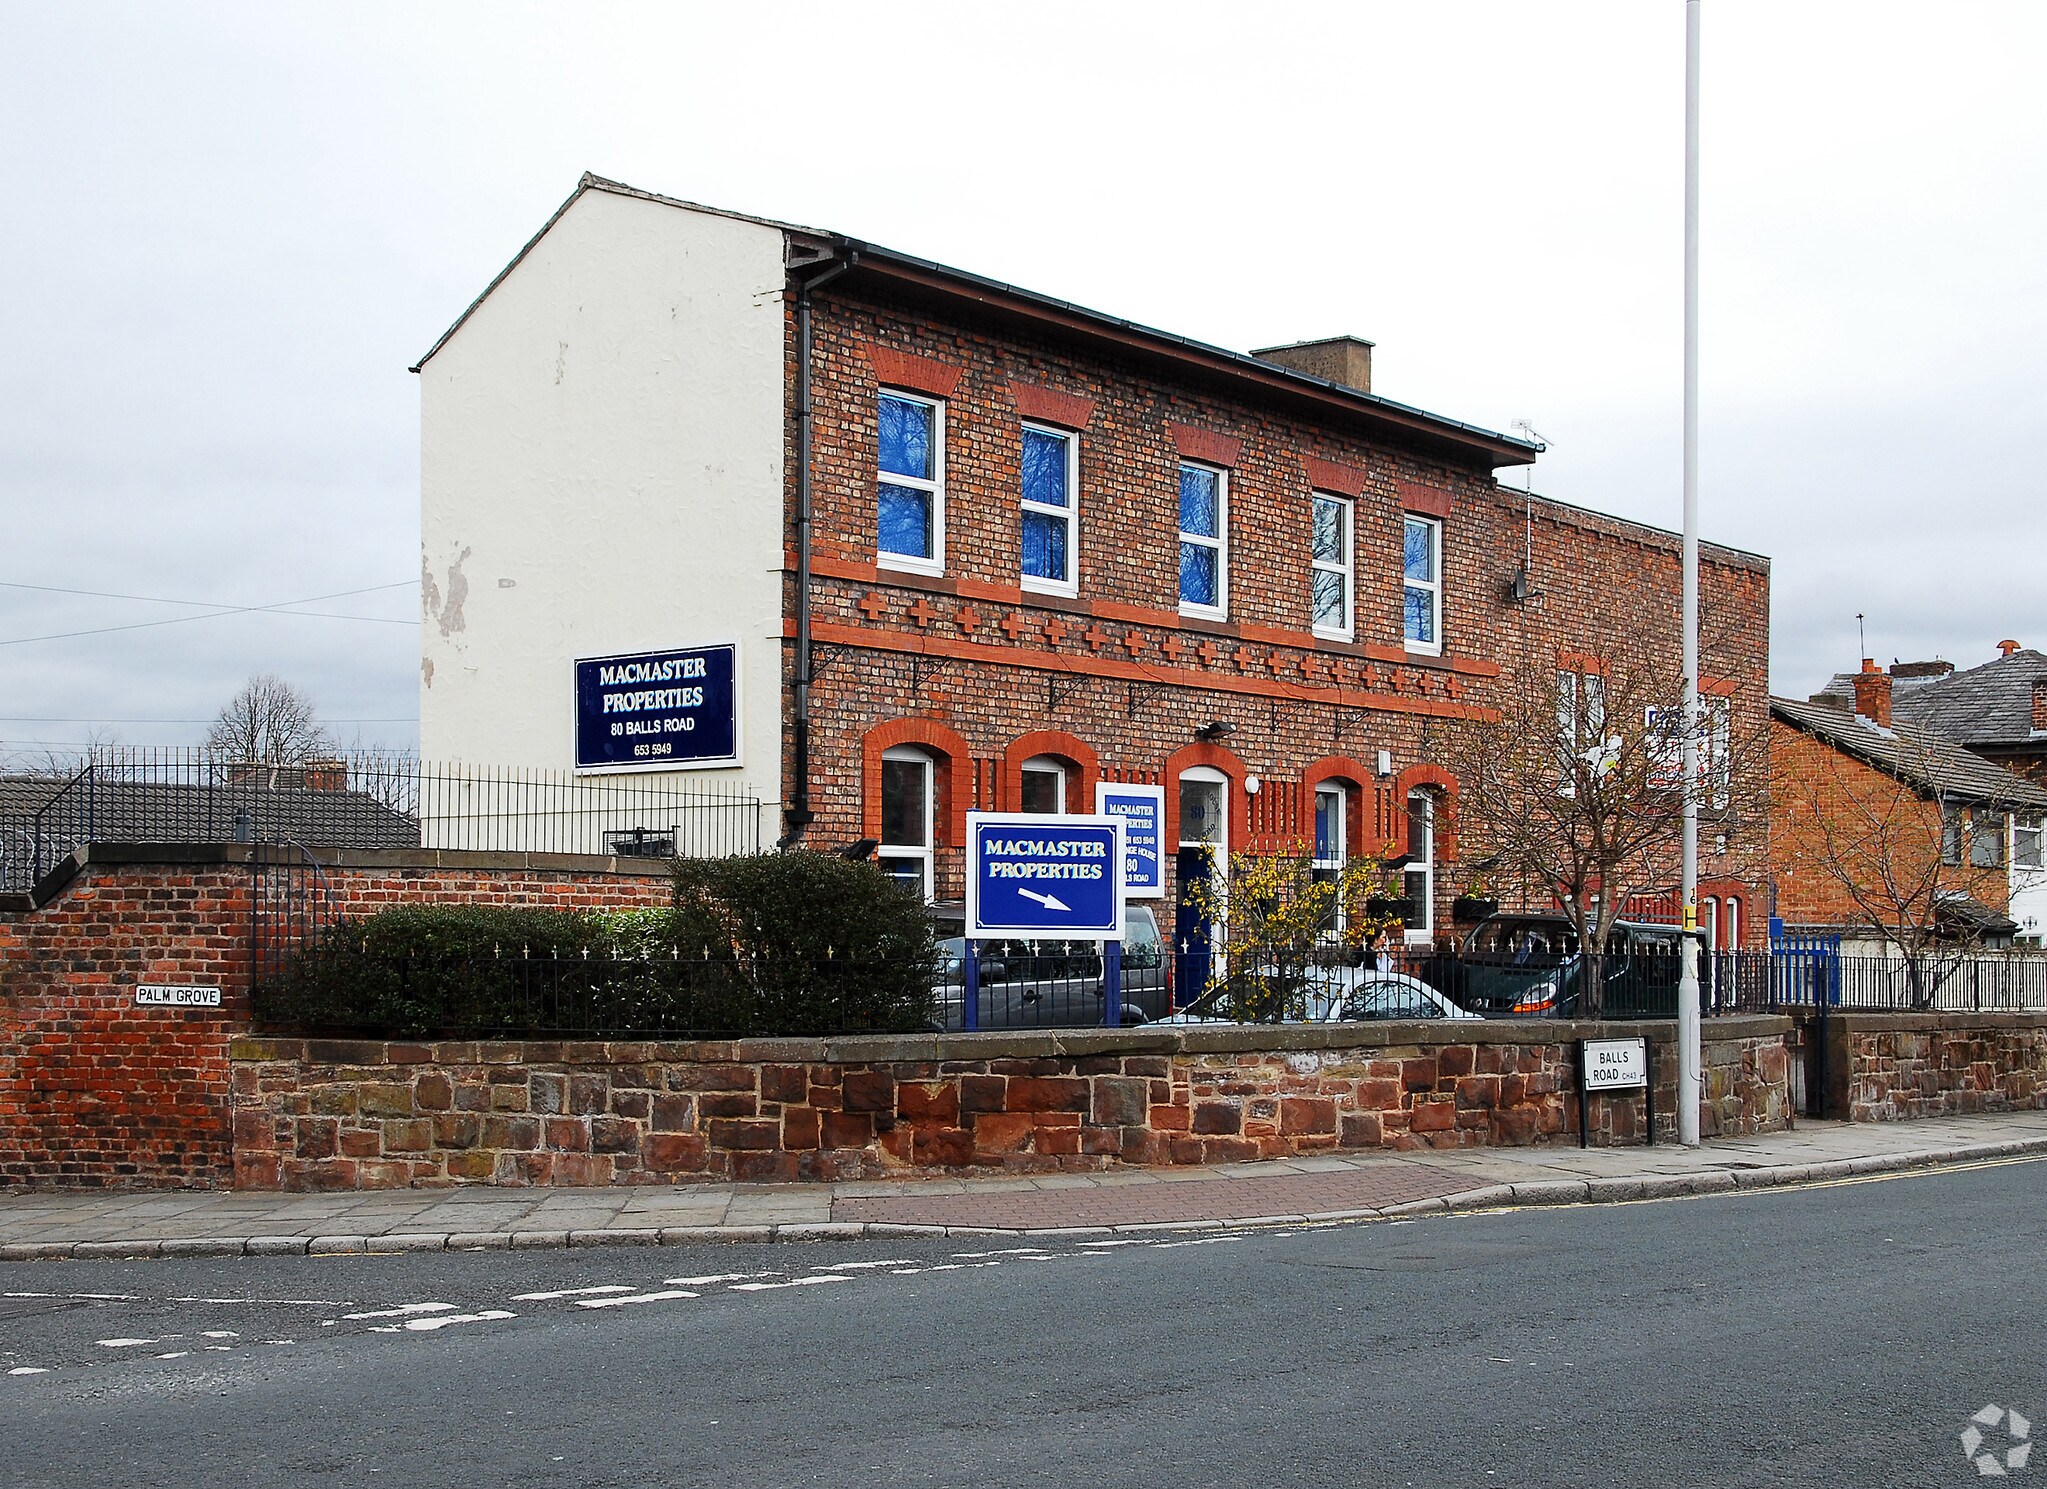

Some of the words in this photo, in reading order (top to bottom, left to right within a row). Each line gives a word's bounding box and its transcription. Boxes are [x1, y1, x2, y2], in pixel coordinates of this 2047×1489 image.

[599, 657, 707, 686] MACMASTER
[603, 686, 704, 714] PROPERTIES
[611, 722, 624, 736] 80
[626, 719, 661, 735] BALLS
[664, 717, 695, 732] ROAD
[634, 744, 650, 756] 653
[651, 743, 672, 755] 5949
[1109, 804, 1155, 816] MACMASTER
[1190, 803, 1205, 819] 80
[1126, 818, 1153, 829] PERTIES
[985, 839, 1106, 858] MACMASTER
[989, 862, 1103, 880] PROPERTIES
[1126, 858, 1138, 872] 80
[1133, 874, 1149, 883] ROAD
[139, 988, 171, 1002] PALM
[176, 990, 217, 1003] GROVE
[1599, 1051, 1629, 1064] BALLS
[1593, 1068, 1619, 1081] ROAD
